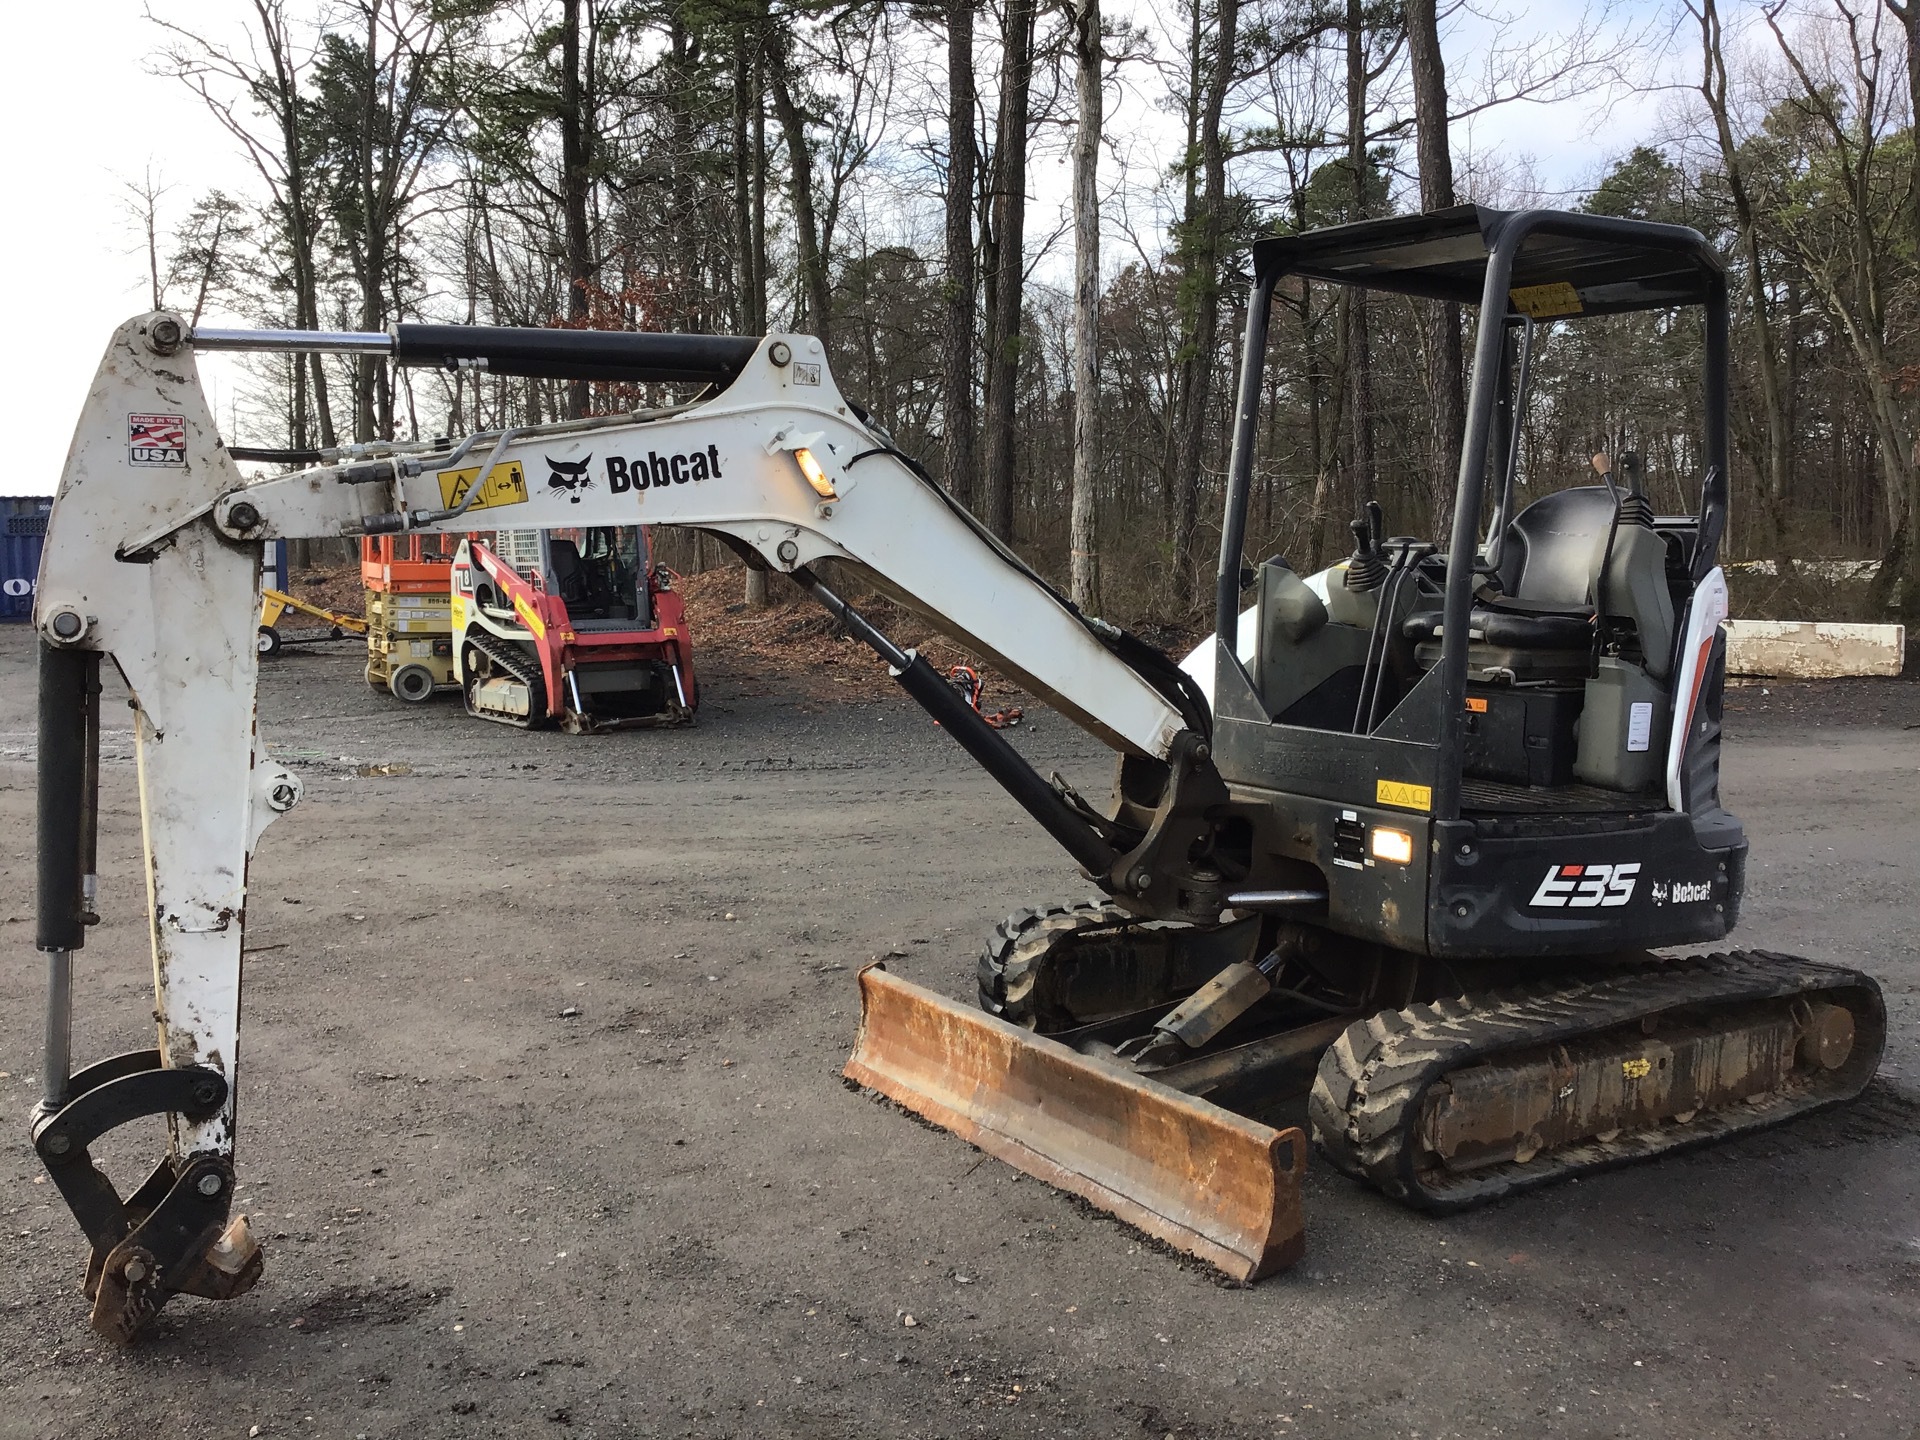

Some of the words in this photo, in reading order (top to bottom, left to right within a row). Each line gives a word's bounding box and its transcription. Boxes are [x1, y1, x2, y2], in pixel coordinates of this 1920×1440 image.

[134, 449, 181, 461] USA
[605, 444, 722, 495] Bobcat
[1528, 862, 1642, 907] E35
[1672, 880, 1712, 904] Bobcat
